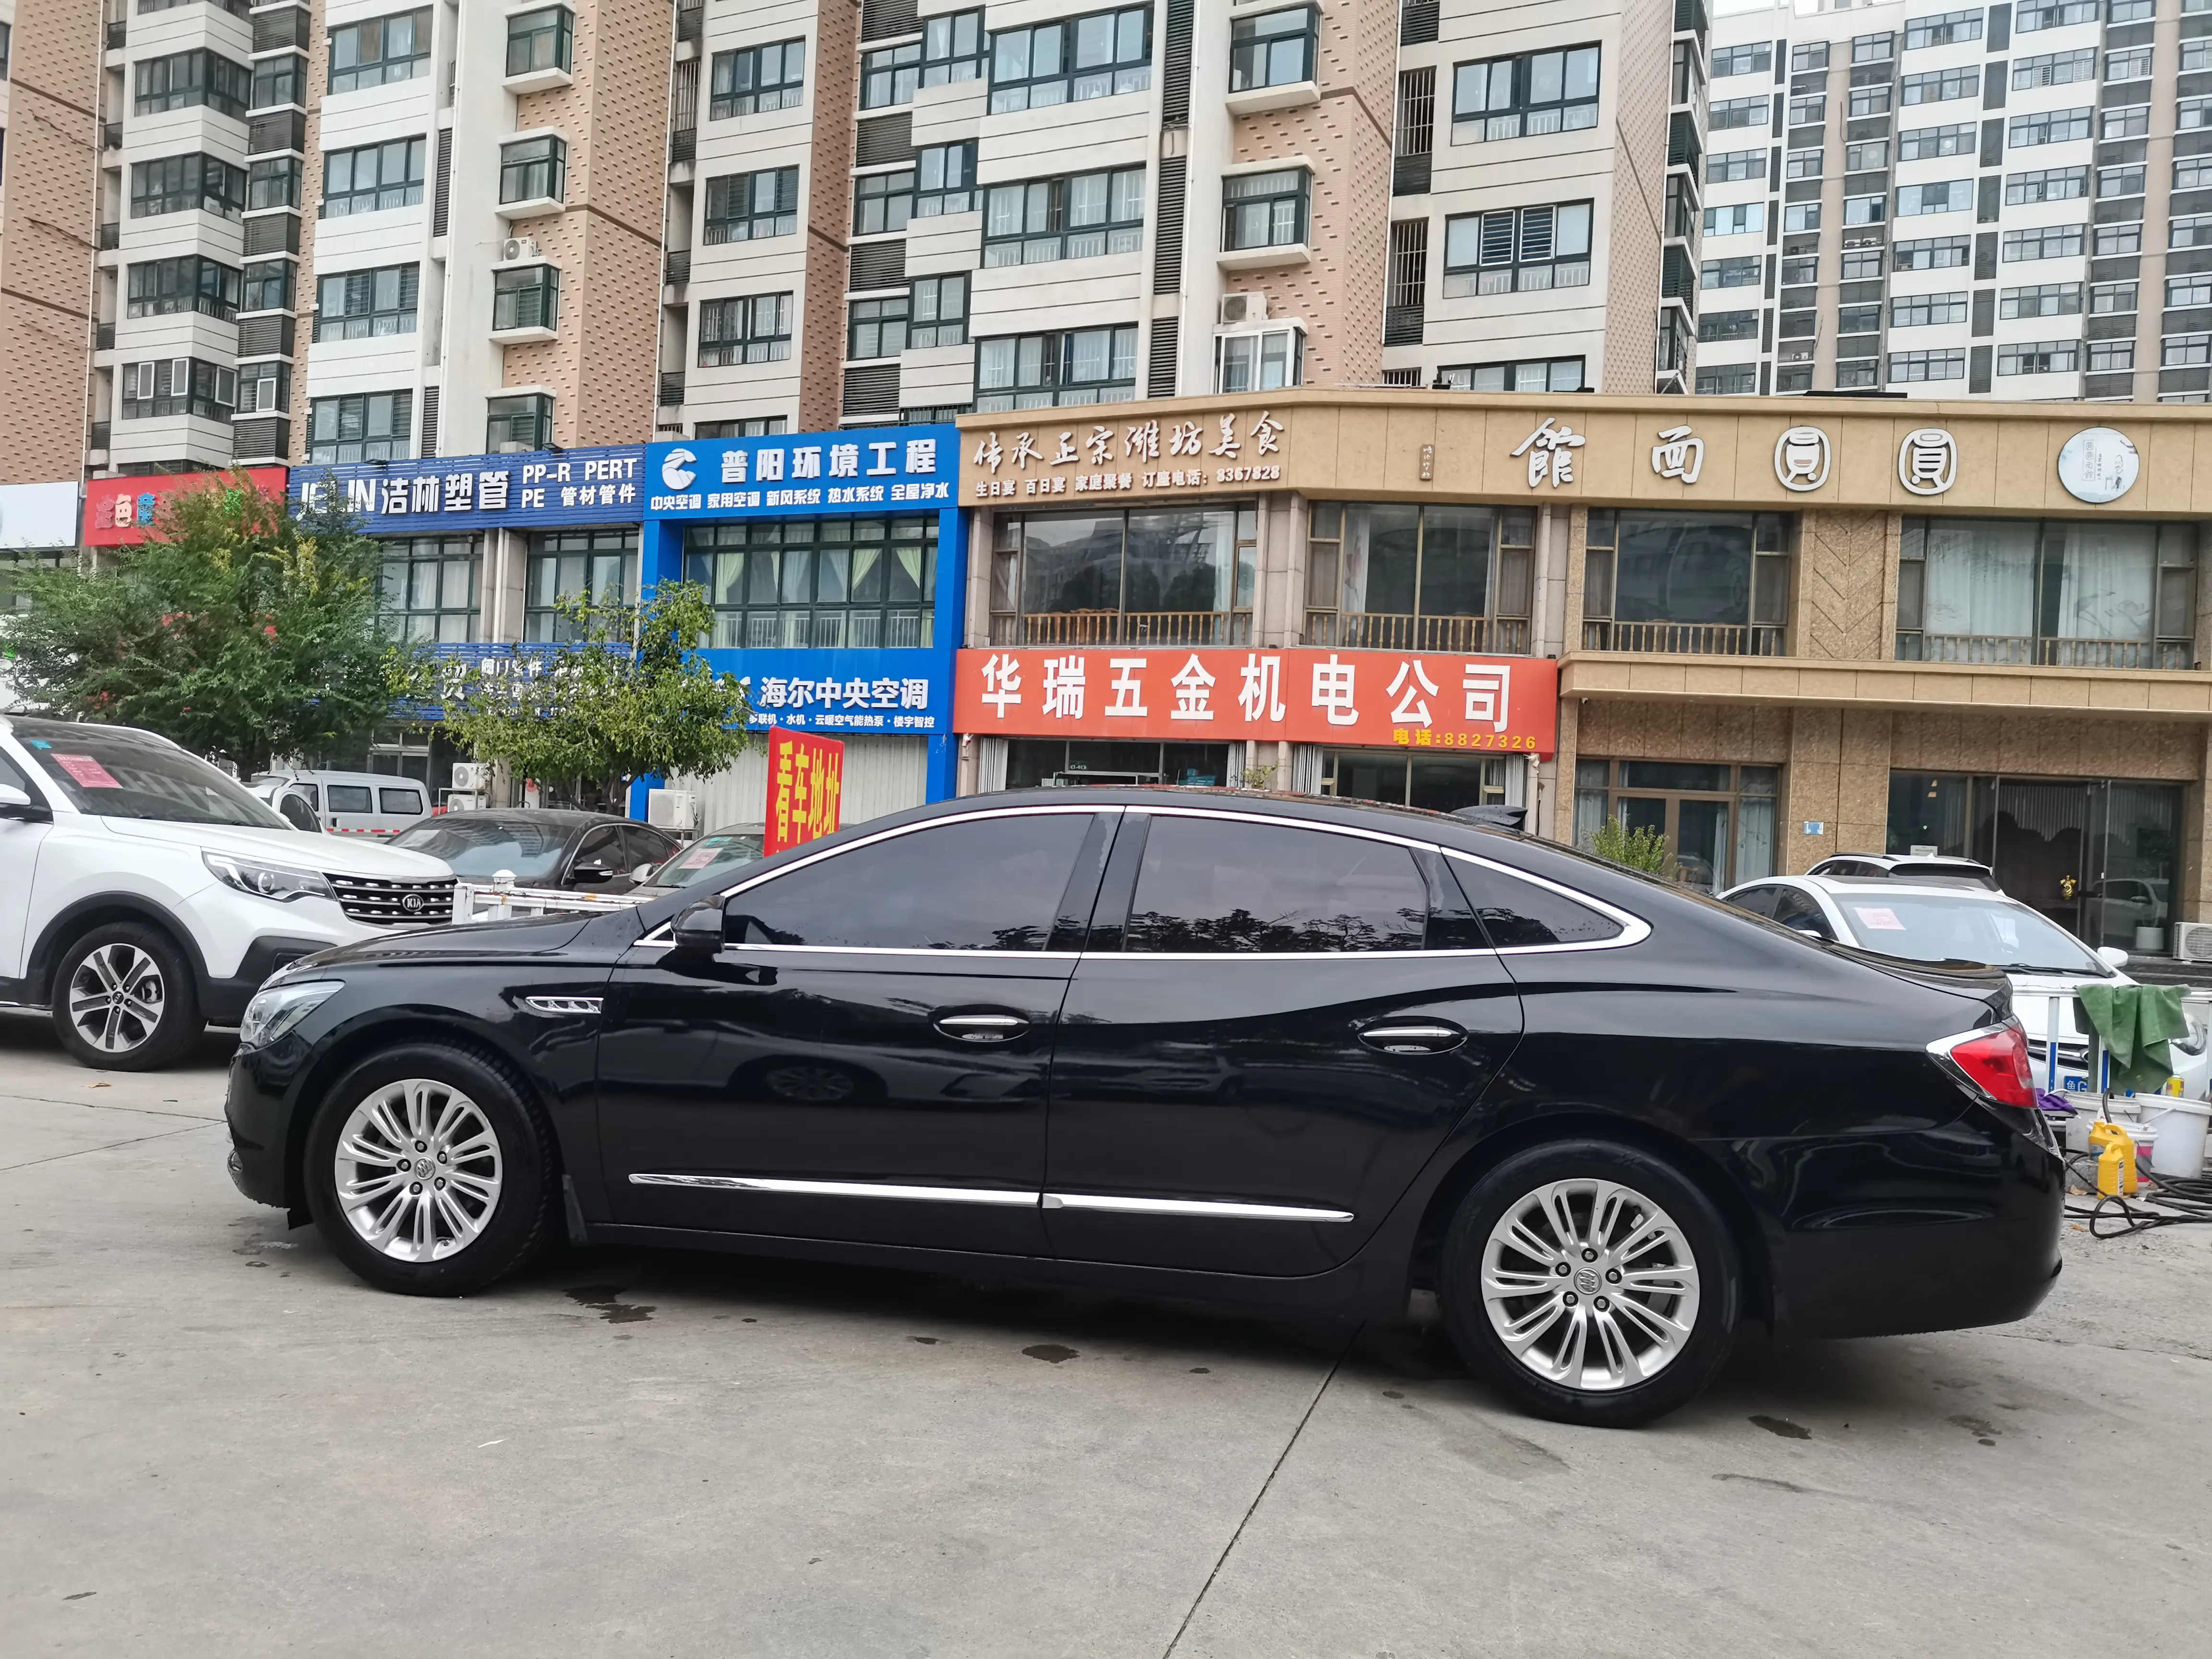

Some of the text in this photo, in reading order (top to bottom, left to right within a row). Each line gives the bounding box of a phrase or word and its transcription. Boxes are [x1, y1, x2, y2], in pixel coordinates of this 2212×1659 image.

[974, 411, 1284, 474] 传承正宗潍坊美食
[522, 457, 638, 484] PP-R PERT
[721, 438, 936, 483] 普阳环境工程
[381, 470, 509, 515] 洁林塑管
[521, 483, 637, 508] PE 管材管件
[650, 481, 950, 511] 中央空调 家用空调 新风系统 热水系统 全屋净水
[975, 479, 1016, 497] 生日宴
[1024, 476, 1066, 494] 百日宴
[1075, 472, 1132, 492] 家庭聚餐
[758, 677, 929, 710] 海尔中央空调
[981, 653, 1511, 733] 华瑞五金机电公司
[775, 740, 840, 844] 看车地址
[407, 898, 421, 908] KIA
